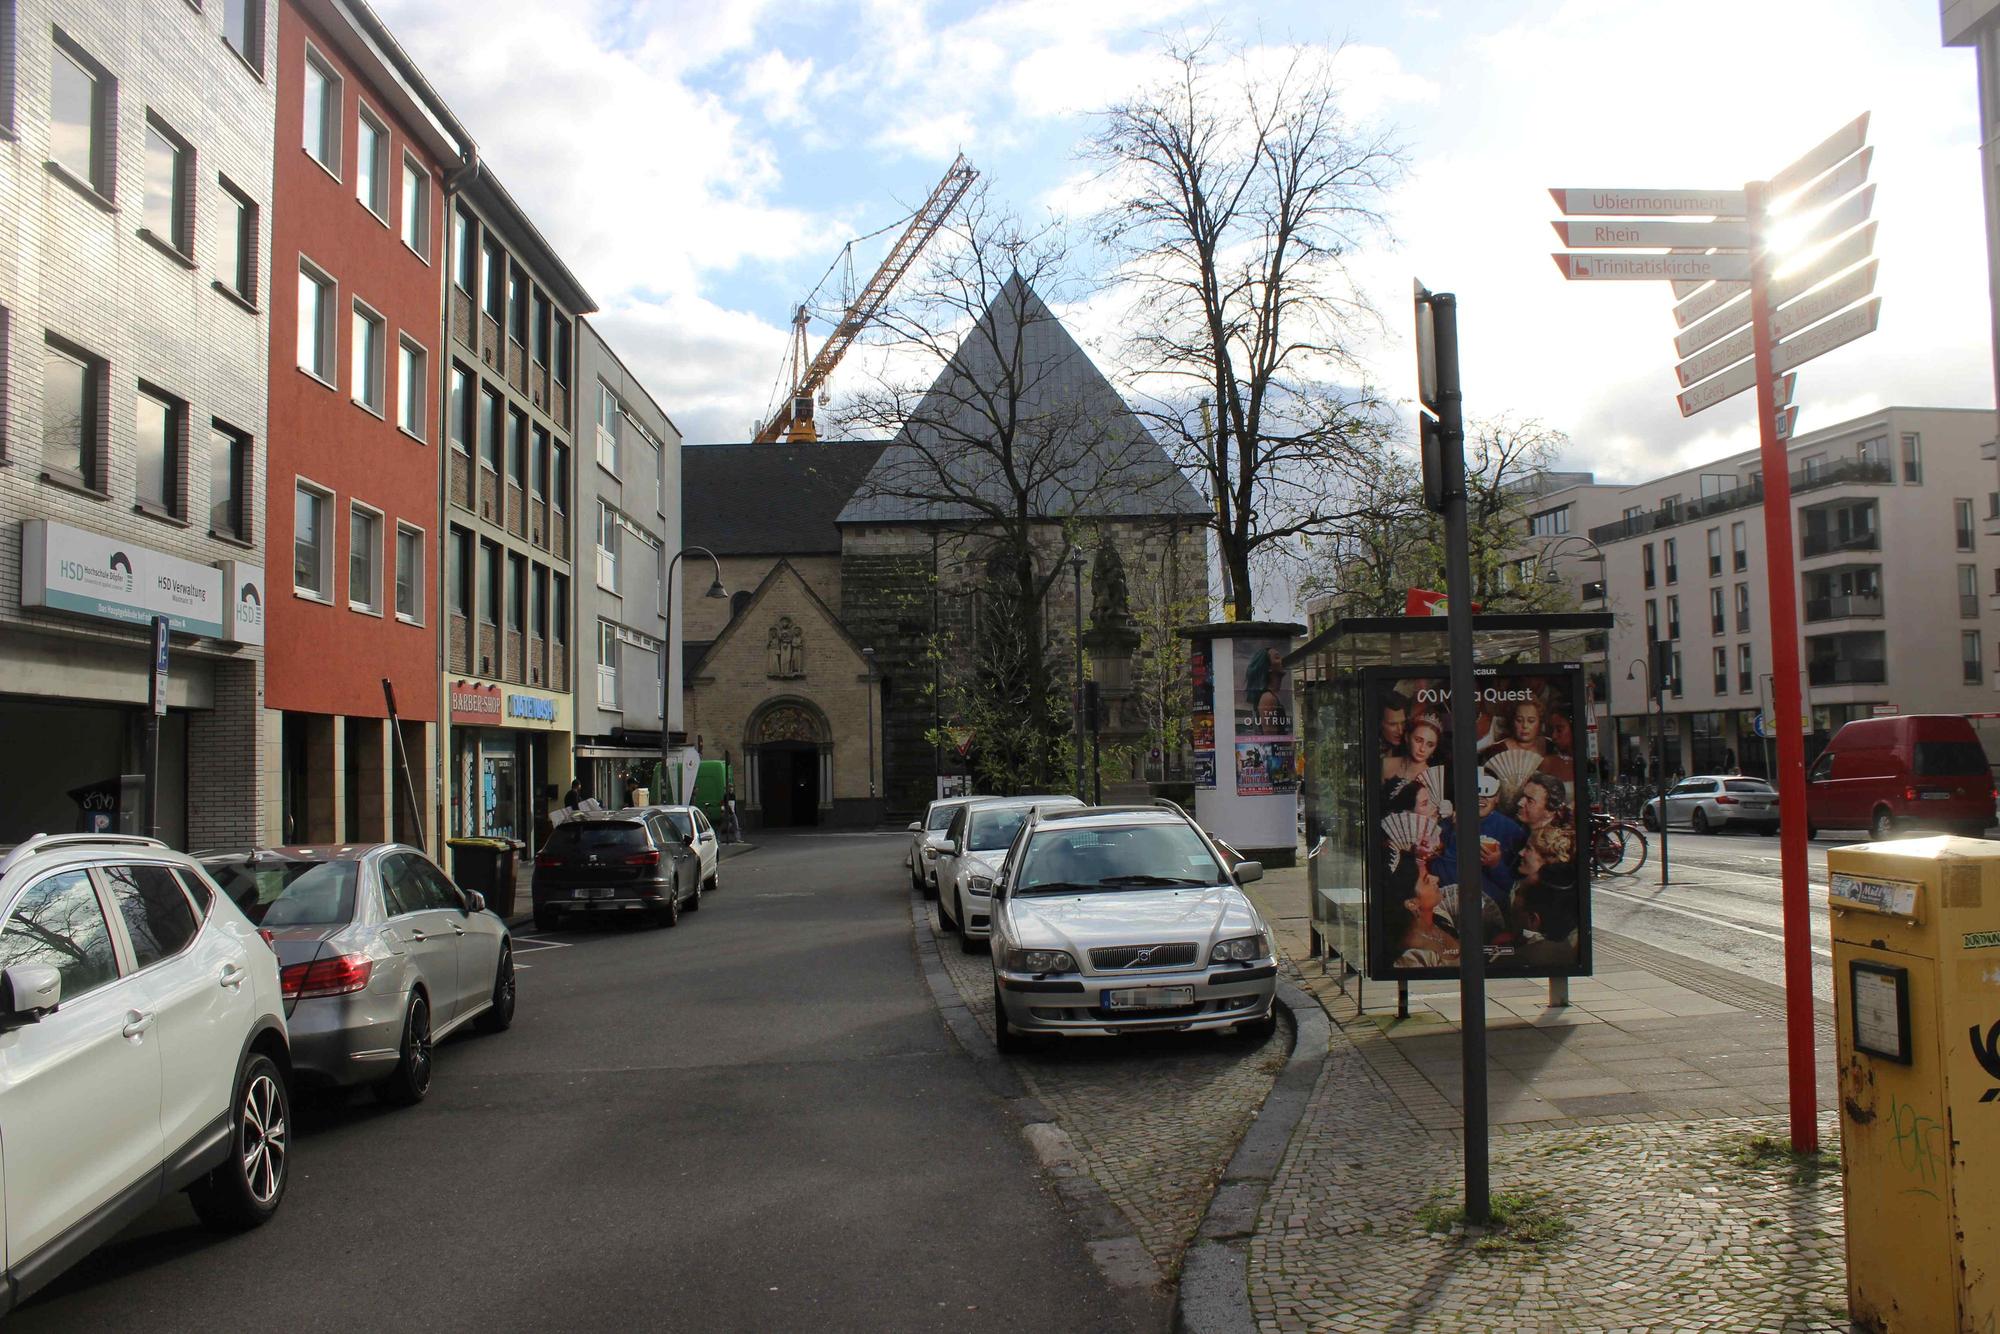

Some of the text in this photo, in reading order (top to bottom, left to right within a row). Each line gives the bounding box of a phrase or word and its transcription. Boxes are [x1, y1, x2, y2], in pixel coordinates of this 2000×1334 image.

[1593, 193, 1727, 209] Ubiermonument
[1595, 226, 1640, 242] Rhein
[1594, 258, 1711, 274] Trinitatiskirche
[61, 559, 84, 581] HSD
[158, 575, 206, 602] HSD Verwaltung
[237, 603, 254, 623] HSD
[160, 622, 167, 663] P
[1440, 688, 1533, 703] Ma Quest
[1244, 717, 1291, 726] OUTRUN
